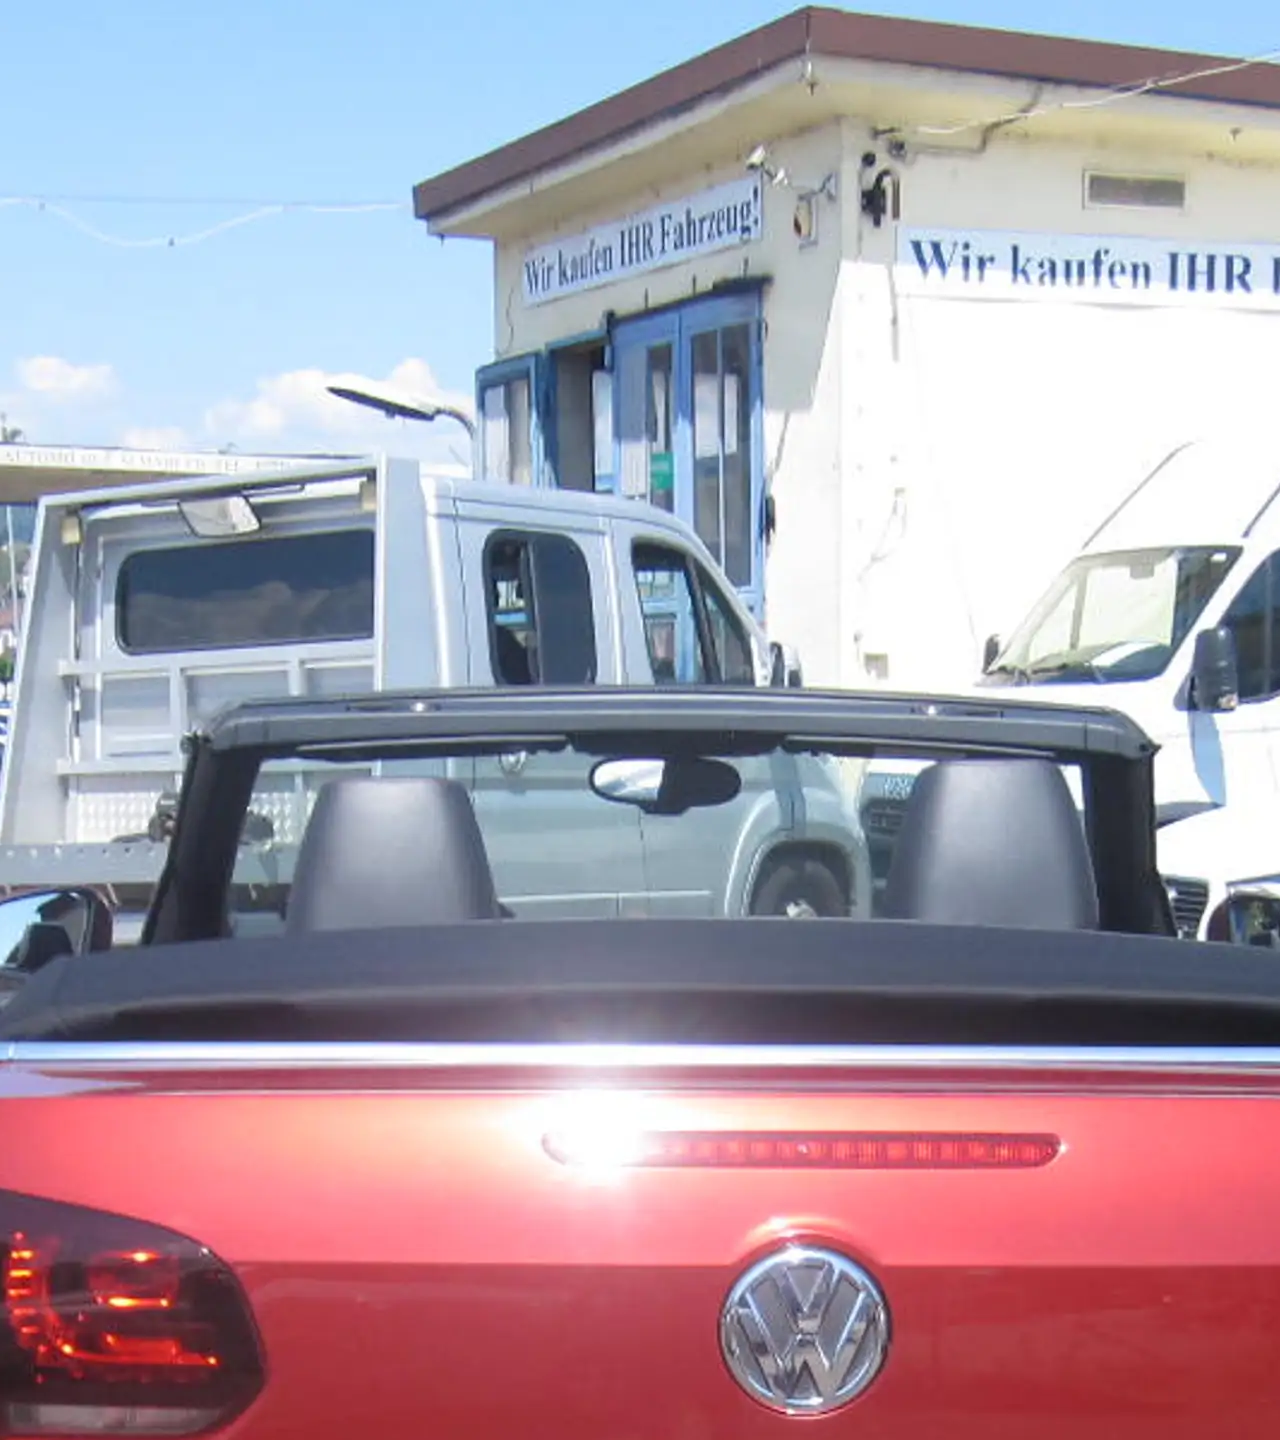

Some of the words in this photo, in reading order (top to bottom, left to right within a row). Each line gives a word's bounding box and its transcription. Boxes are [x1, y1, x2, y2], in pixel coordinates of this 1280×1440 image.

[524, 252, 554, 294] Wir
[557, 238, 613, 285] kaufen
[620, 221, 655, 267] IHR
[660, 184, 760, 252] Fahrzeug!
[910, 239, 995, 283] Wir
[1011, 245, 1151, 289] kaufen
[1167, 251, 1252, 293] IHR
